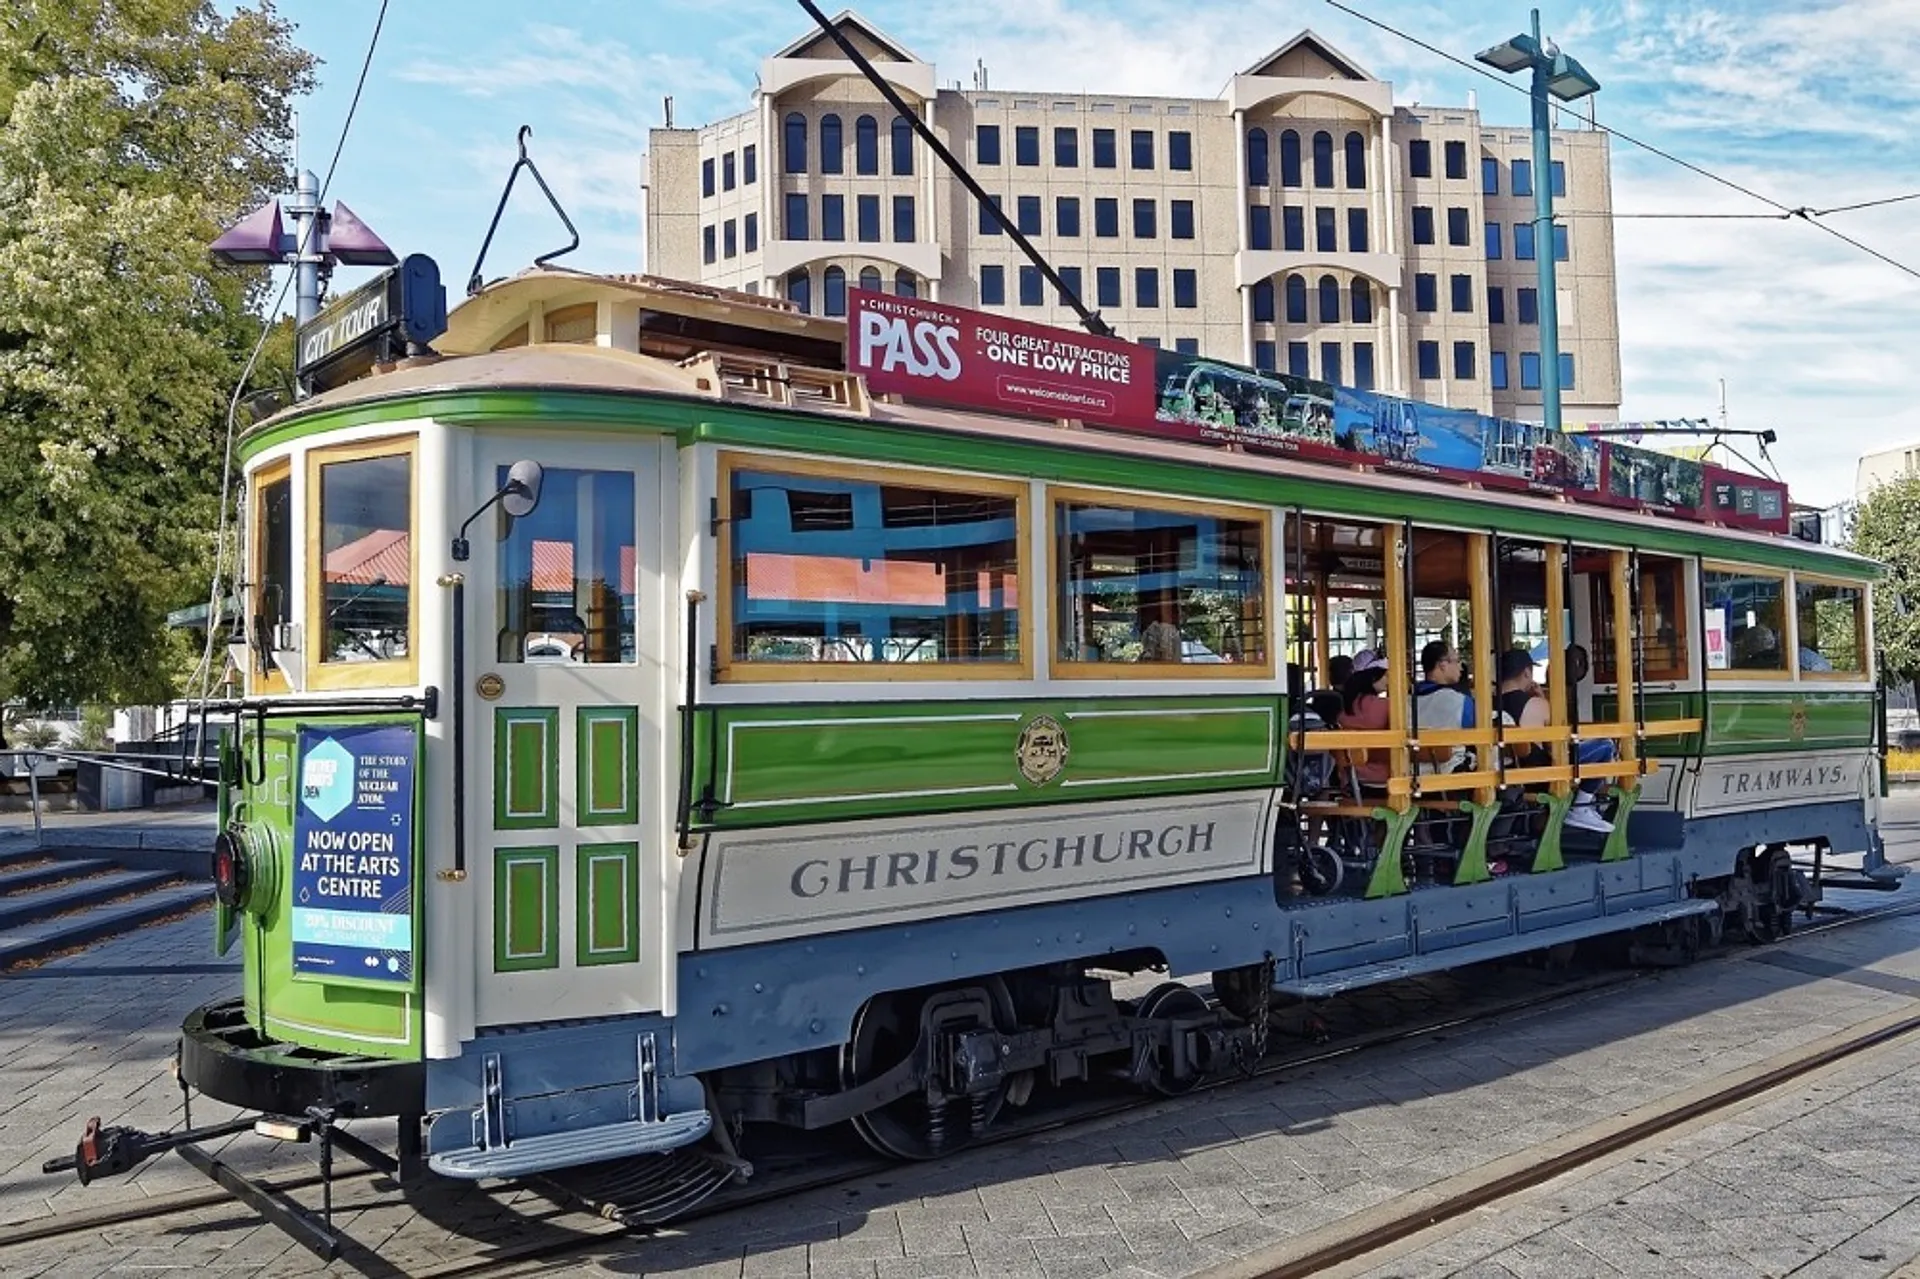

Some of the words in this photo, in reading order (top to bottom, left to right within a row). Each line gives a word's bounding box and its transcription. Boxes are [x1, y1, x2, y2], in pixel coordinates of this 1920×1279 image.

[869, 300, 953, 323] CHRISTCHURCH
[304, 324, 334, 363] CITY
[339, 295, 381, 340] TOUR
[859, 310, 961, 380] PASS
[975, 326, 1010, 346] FOUR
[1012, 333, 1050, 353] GREAT
[1052, 341, 1130, 368] ATTRACTIONS
[987, 345, 1028, 367] ONE
[1033, 353, 1076, 374] LOW
[1081, 362, 1130, 384] PRICE
[359, 768, 370, 778] OF
[372, 768, 389, 778] THE
[358, 781, 399, 792] NUCLEAR
[308, 830, 347, 850] NOW
[349, 831, 393, 852] OPEN
[300, 852, 321, 872] AT
[322, 854, 355, 874] THE
[357, 855, 400, 877] ARTS
[790, 821, 1218, 898] CHRISTCHURCH
[317, 876, 382, 898] CENTRE
